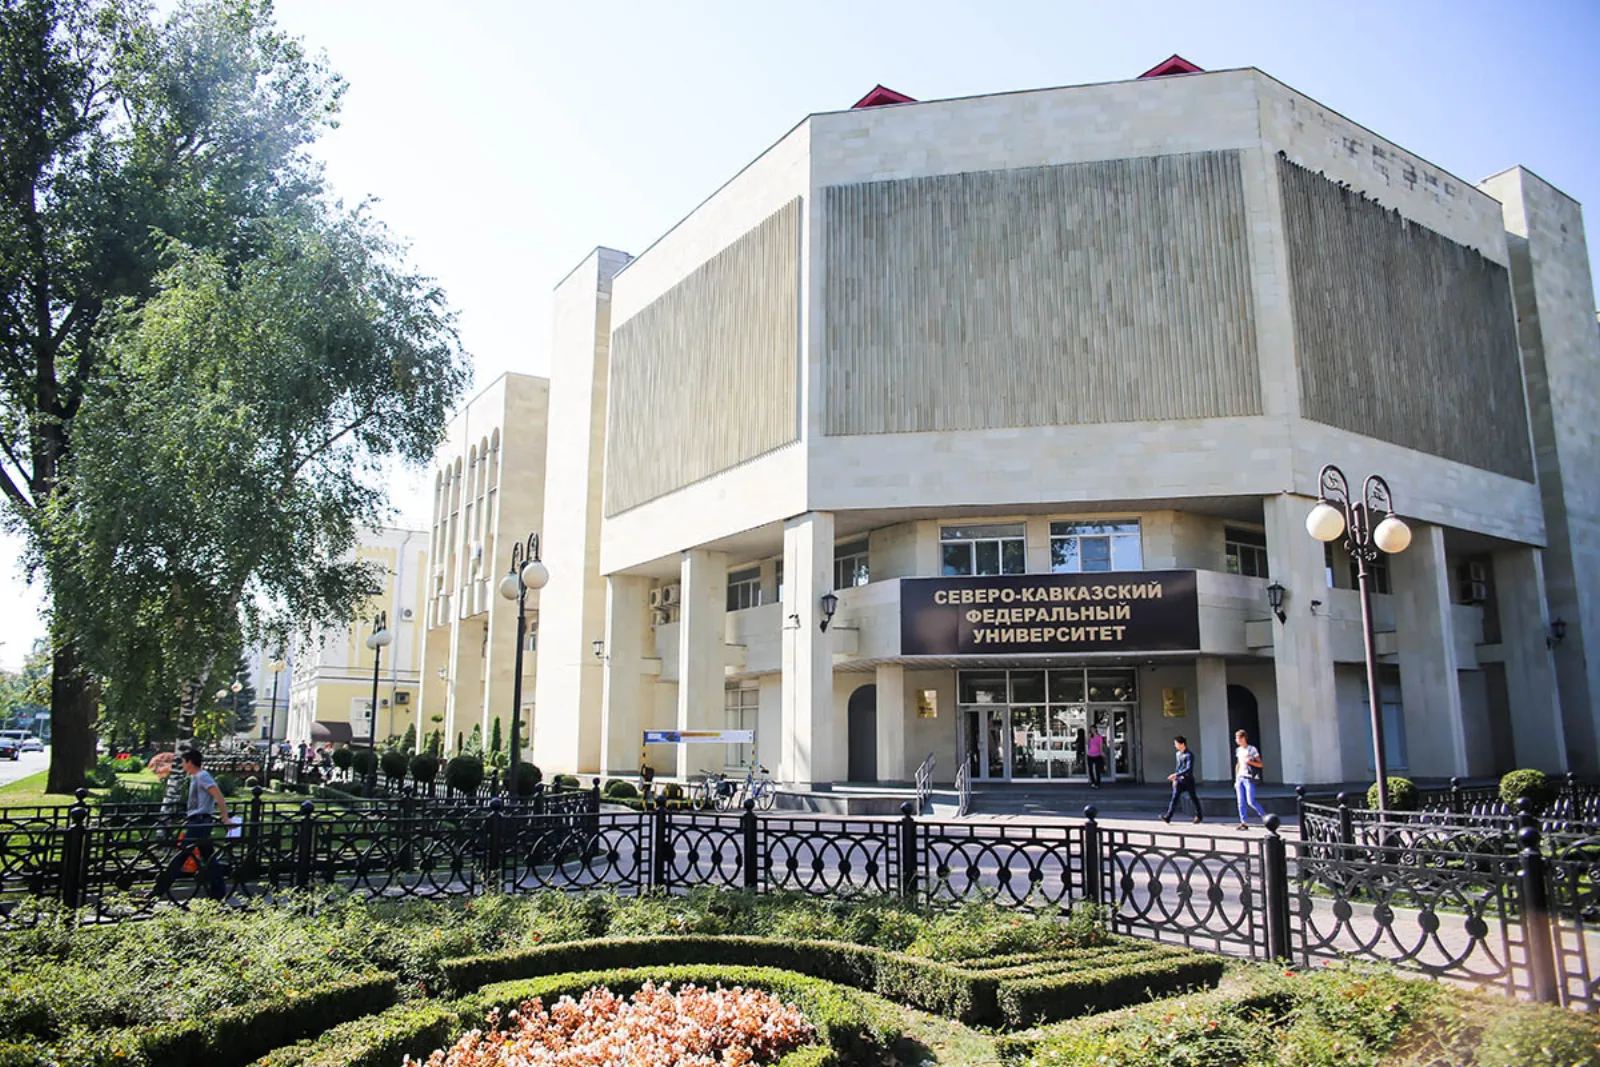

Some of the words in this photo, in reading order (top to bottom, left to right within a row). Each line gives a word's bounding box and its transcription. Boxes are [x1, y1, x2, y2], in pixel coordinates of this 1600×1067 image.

[934, 581, 1162, 604] СЕВЕРО-КАВКАЗСКИЙ
[965, 602, 1131, 626] ФЕДЕРАЛЬНЫЙ
[973, 626, 1126, 644] УНИВЕРСИТЕТ
